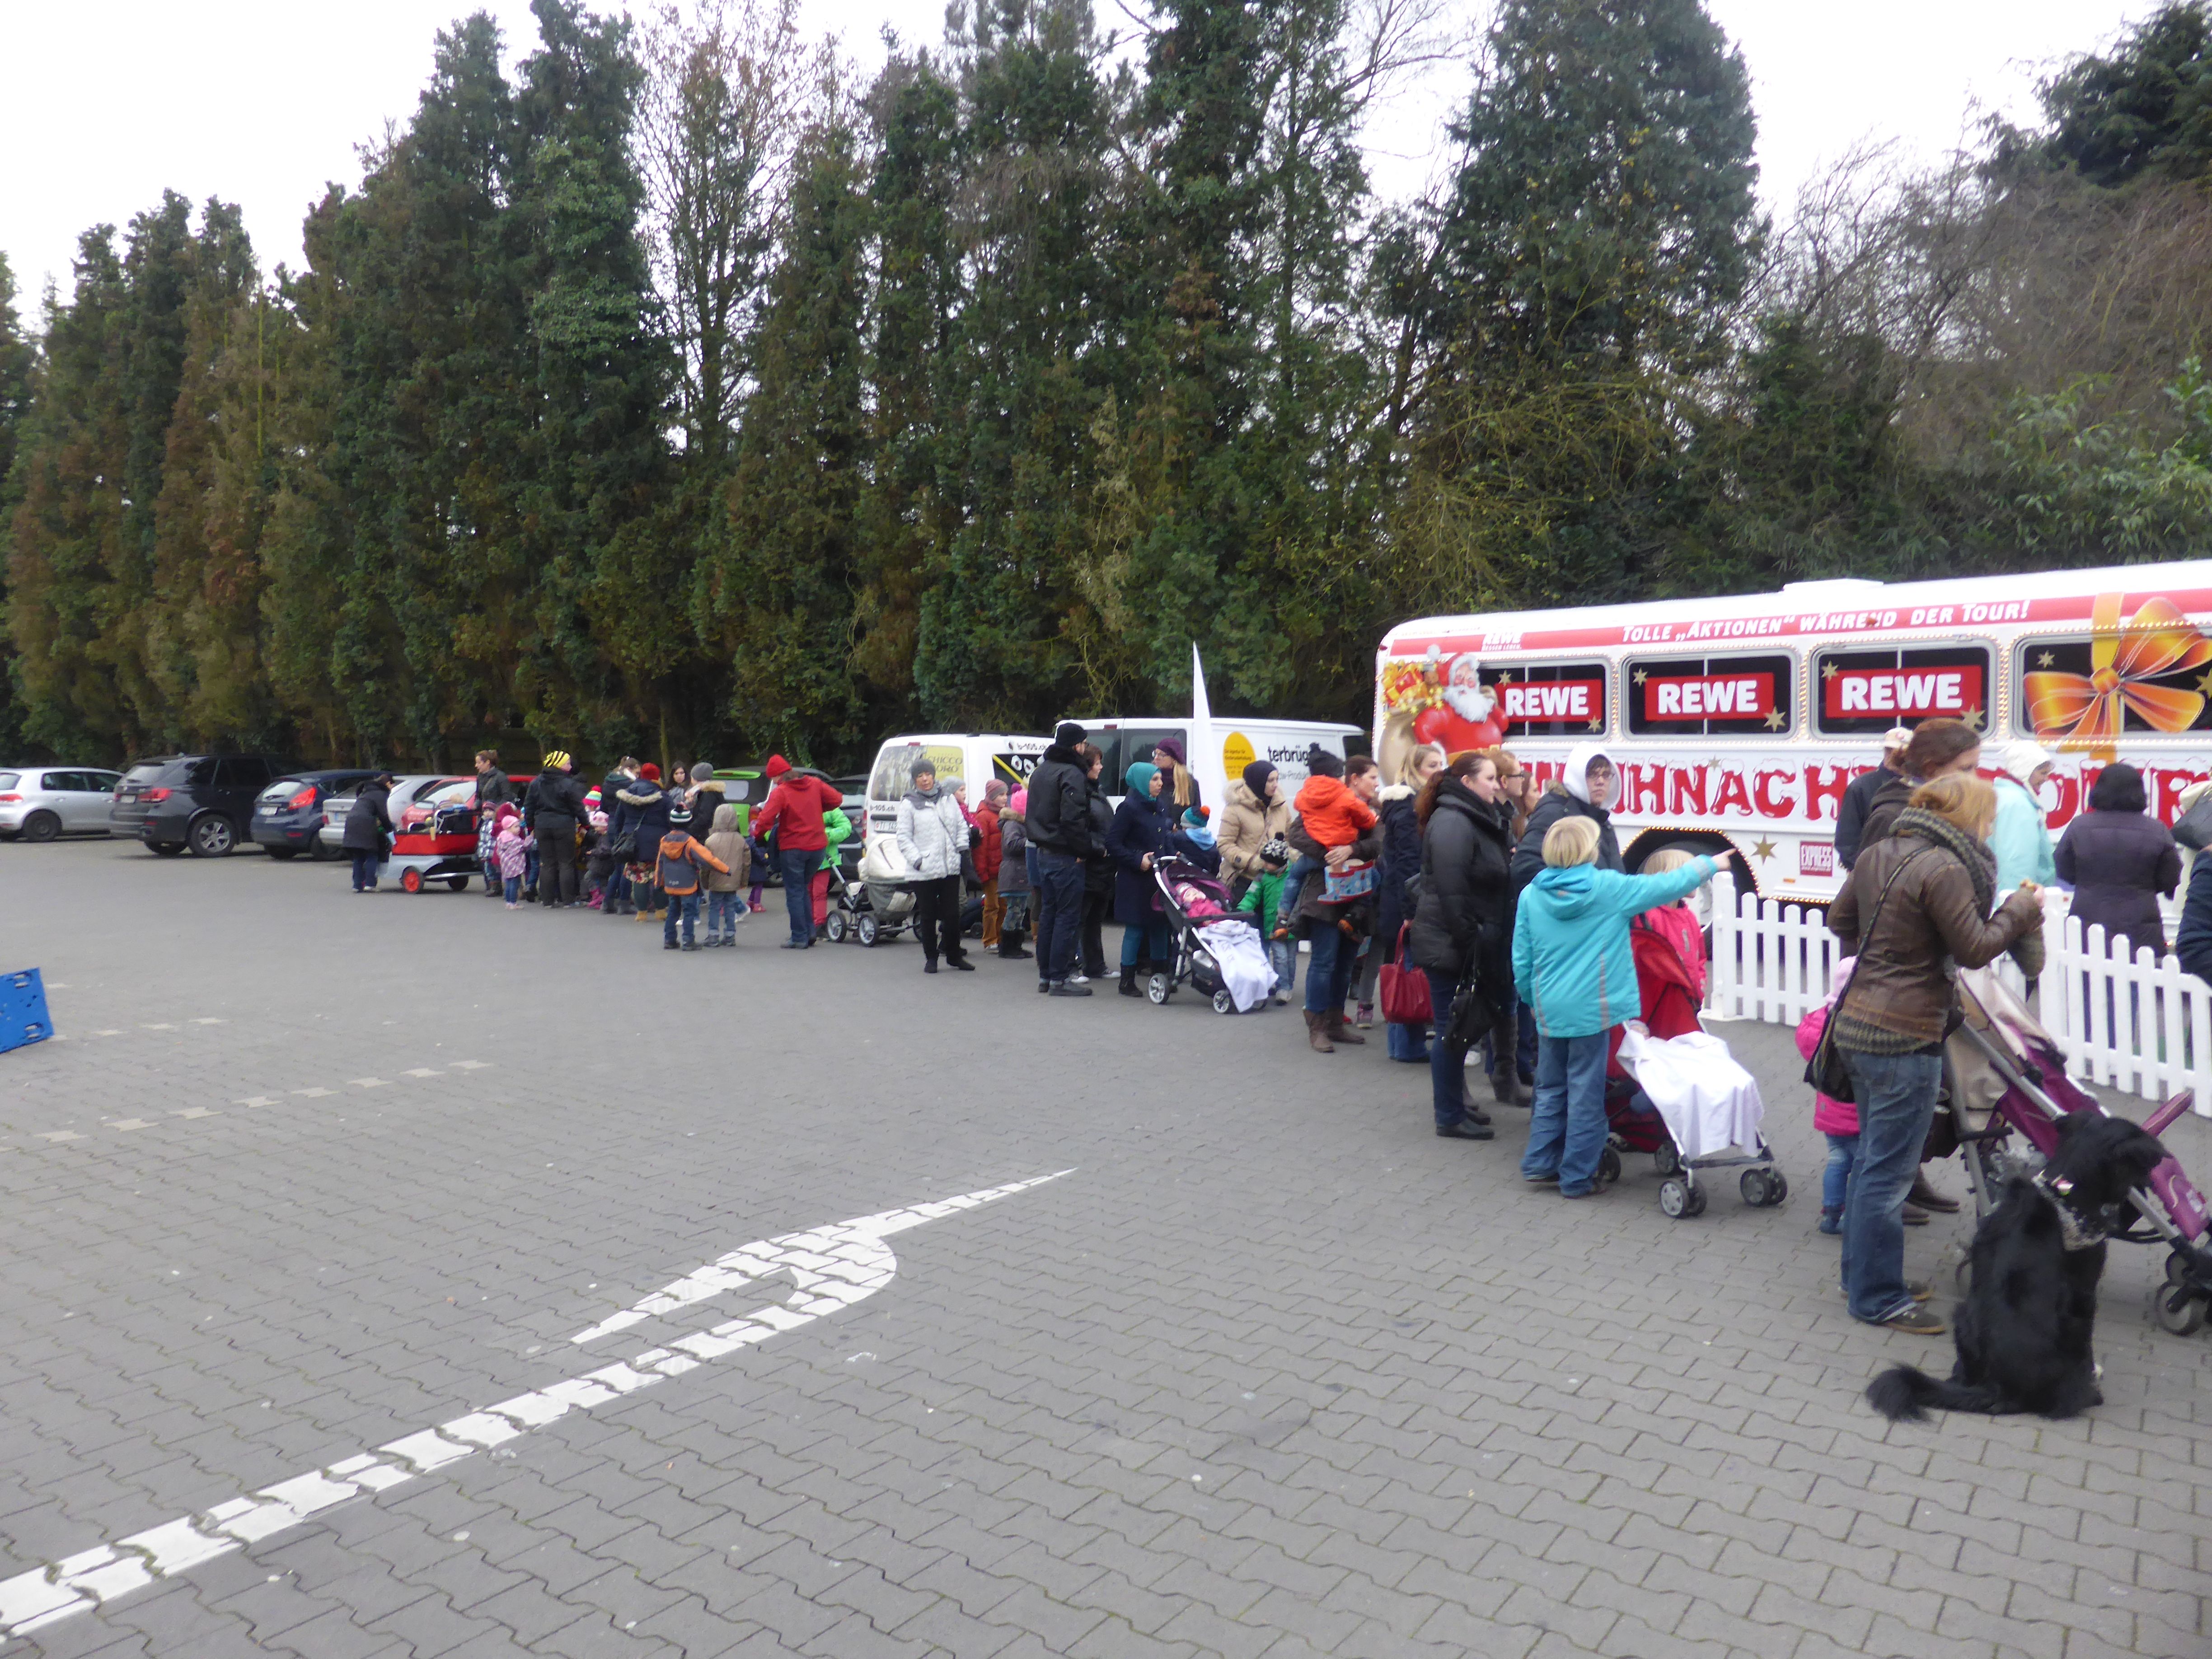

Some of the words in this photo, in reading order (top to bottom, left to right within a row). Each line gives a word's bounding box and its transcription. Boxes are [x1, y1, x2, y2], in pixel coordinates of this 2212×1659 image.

[1622, 625, 1672, 642] TOLLE
[1910, 607, 1954, 625] DER
[1962, 600, 2030, 623] TOUR!
[1505, 686, 1589, 717] REWE
[1658, 680, 1758, 714] REWE
[1842, 673, 1963, 710] REWE
[1267, 745, 1309, 766] terbrüg
[1801, 845, 1832, 867] EXPRESS
